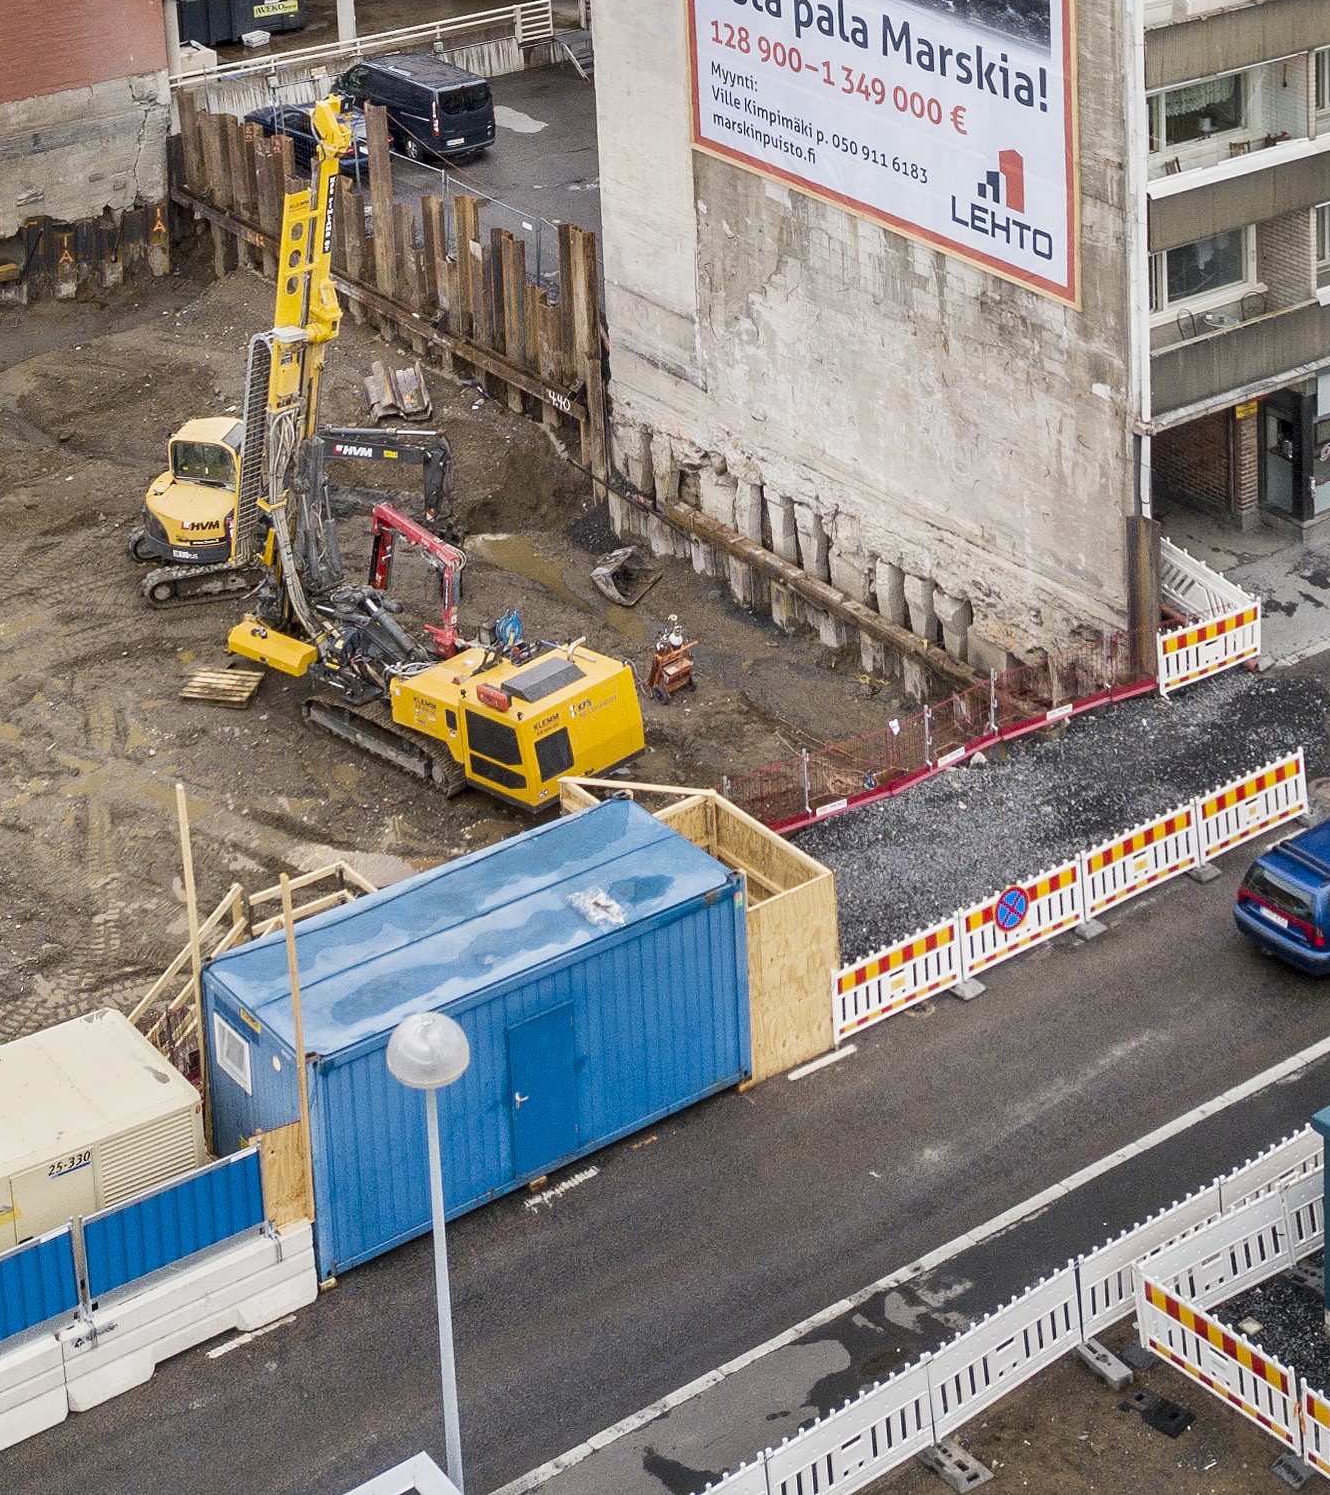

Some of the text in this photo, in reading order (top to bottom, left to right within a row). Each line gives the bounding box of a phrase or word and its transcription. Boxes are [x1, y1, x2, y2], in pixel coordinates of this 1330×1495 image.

[711, 60, 759, 93] Myynti:
[711, 20, 752, 54] 128
[841, 65, 886, 105] 349
[893, 85, 943, 125] 000
[950, 105, 968, 135] €
[881, 14, 1048, 113] Marskia!
[711, 84, 929, 184] Ville Kimpimäki p. 050 911 6183
[713, 112, 817, 165] marskinpuisto.fi
[951, 195, 1053, 260] LEHTO
[342, 445, 373, 458] HVM
[191, 520, 220, 531] HVM
[48, 1150, 92, 1177] 25-330
